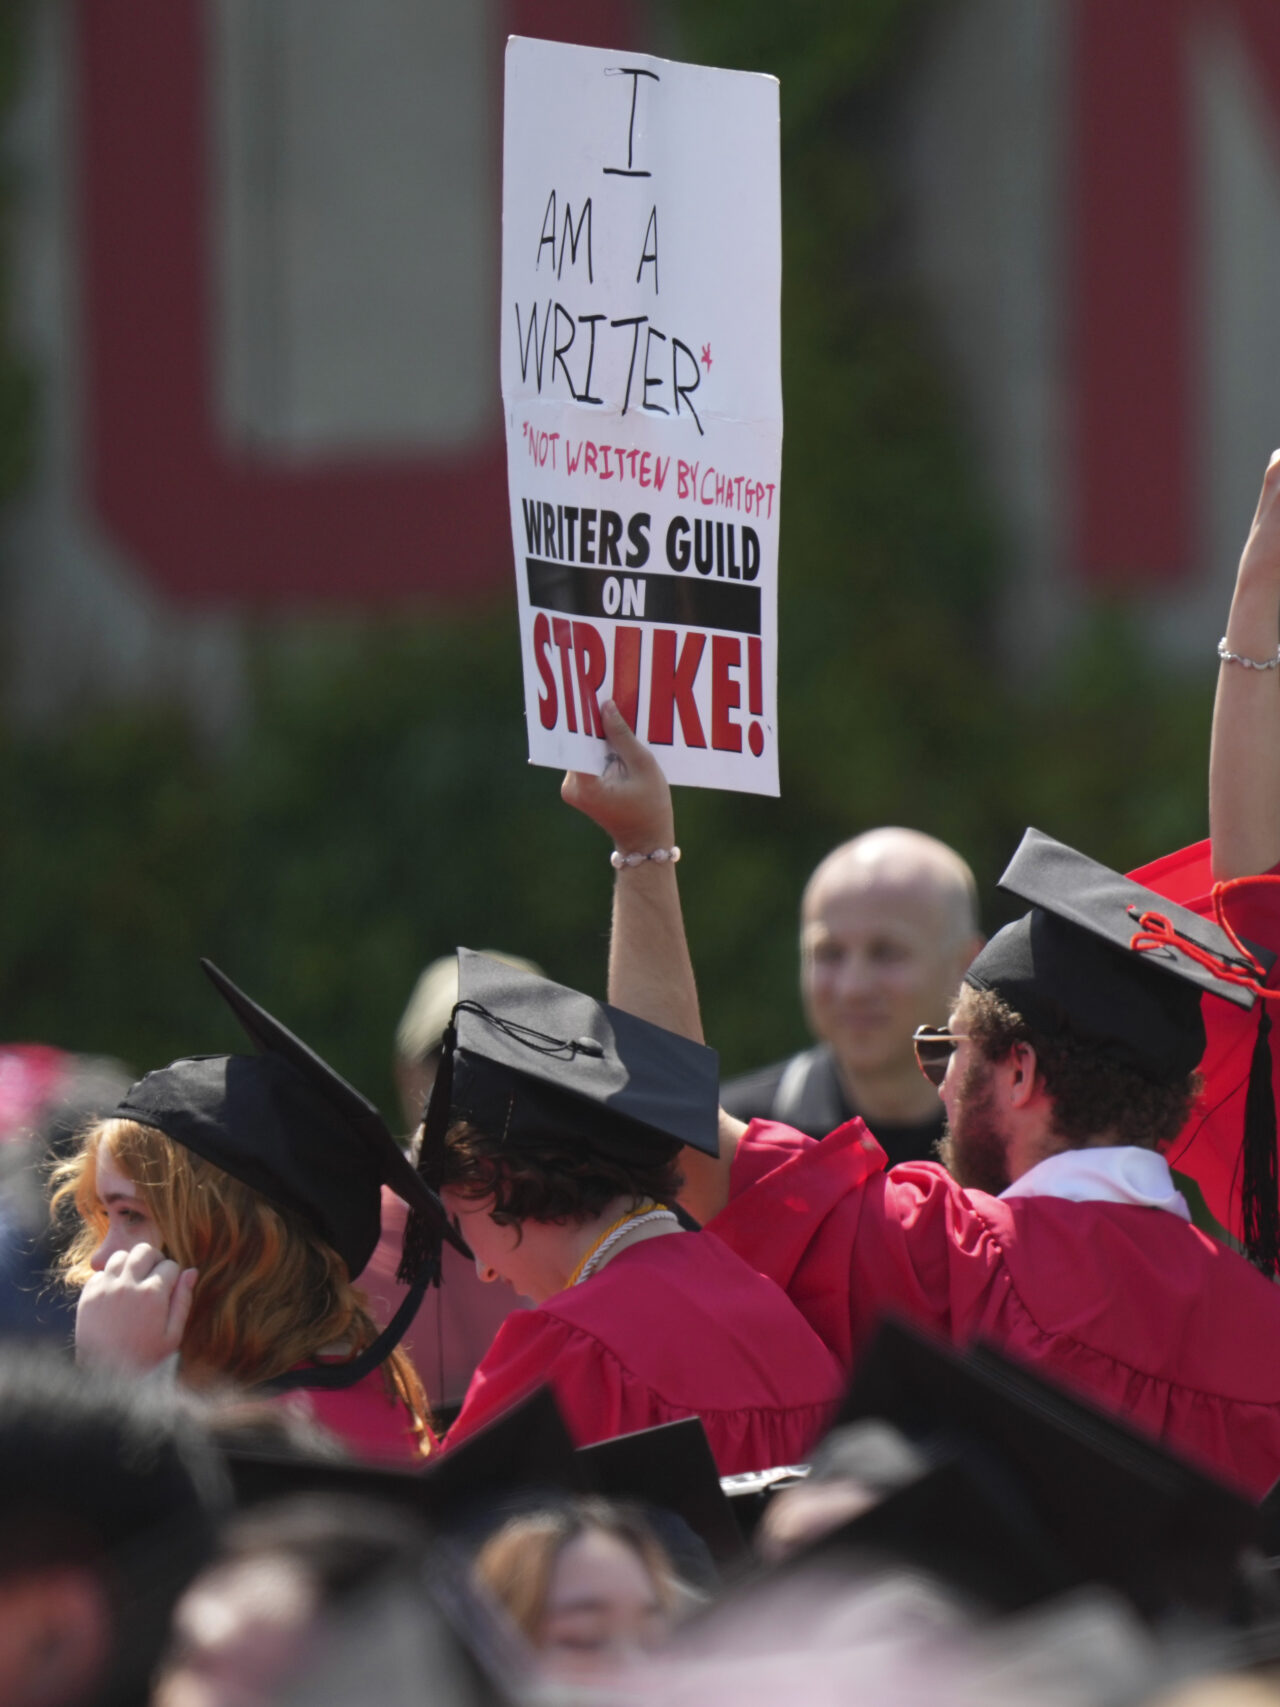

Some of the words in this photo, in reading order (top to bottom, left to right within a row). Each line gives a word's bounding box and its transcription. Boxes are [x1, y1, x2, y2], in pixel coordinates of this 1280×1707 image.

[603, 67, 660, 178] I
[536, 189, 593, 284] AM
[636, 204, 658, 296] A
[566, 440, 670, 492] WRITTEN
[677, 459, 699, 501] BY
[701, 467, 776, 519] CHATGPT
[522, 498, 651, 568] WRITERS
[666, 515, 760, 581] GUILD
[602, 576, 646, 617] ON
[533, 612, 764, 757] STRIKE!
